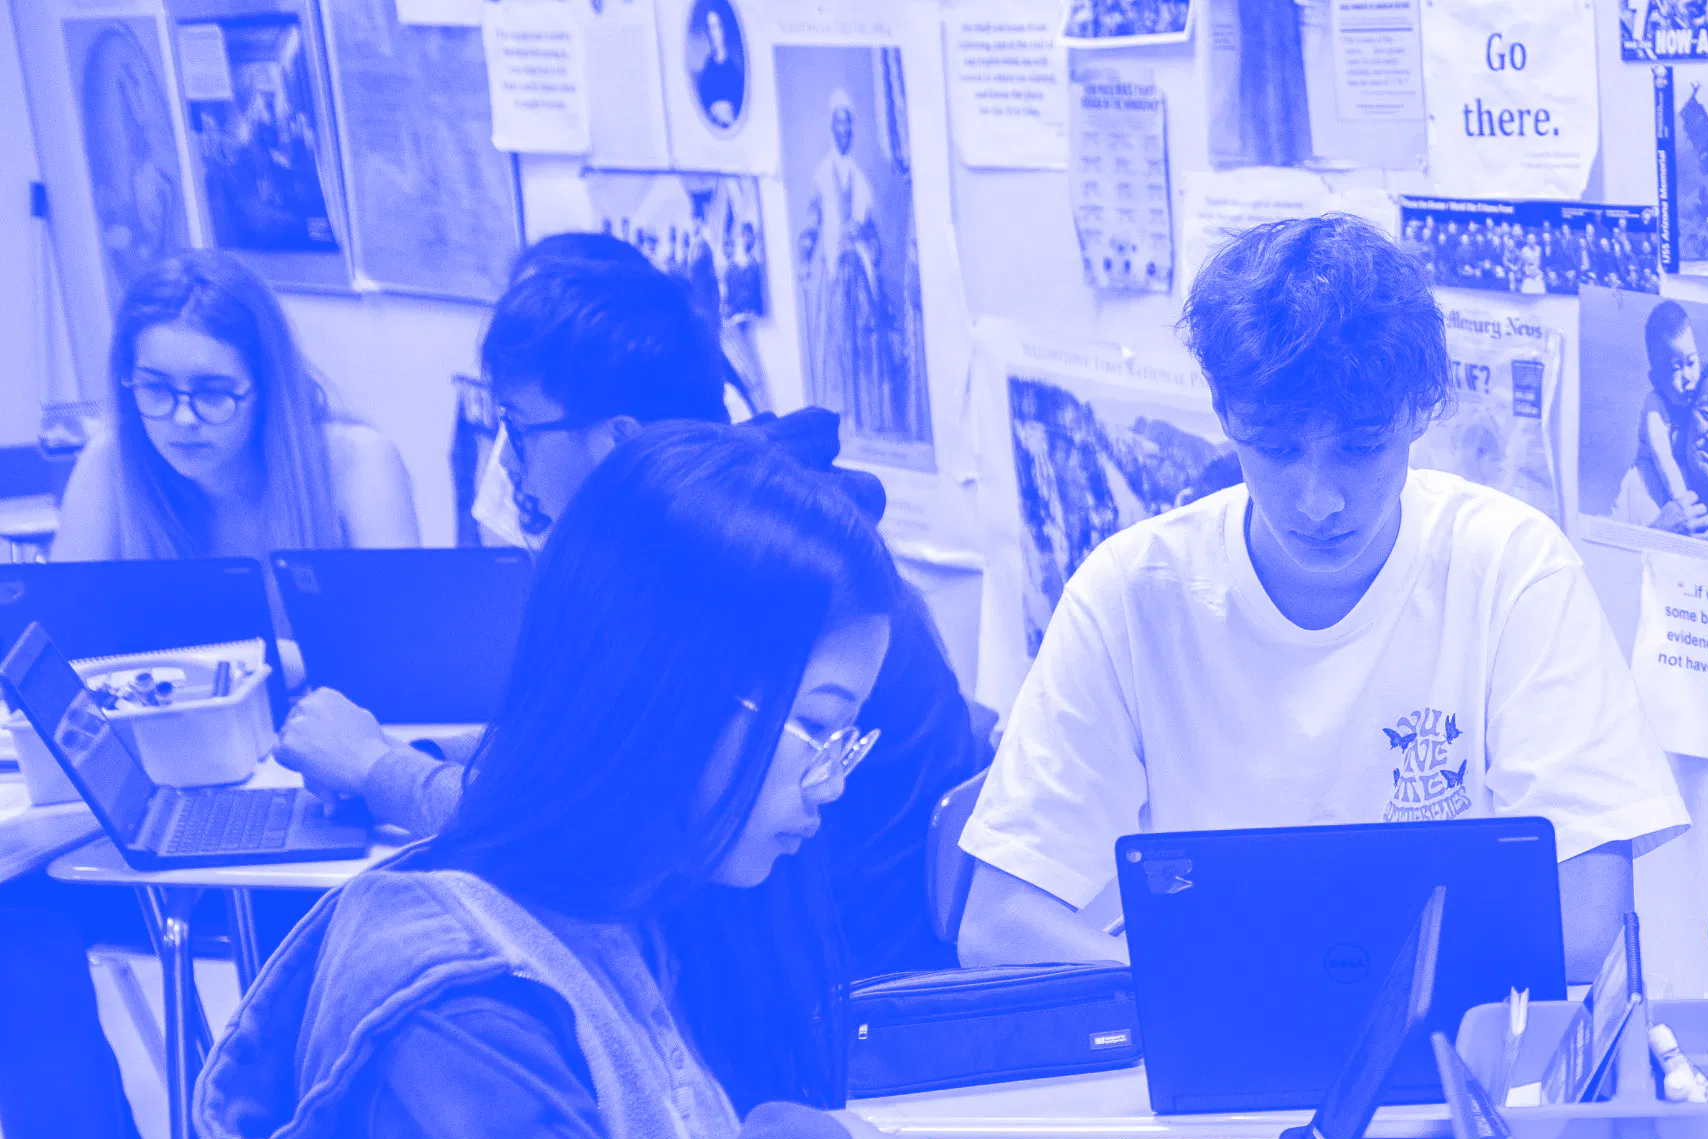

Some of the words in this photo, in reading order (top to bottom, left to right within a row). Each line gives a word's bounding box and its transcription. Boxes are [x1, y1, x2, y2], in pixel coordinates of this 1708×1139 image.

[1485, 32, 1527, 72] Go
[1462, 98, 1560, 137] there.
[1505, 316, 1542, 339] News
[1465, 363, 1491, 394] IF?
[1664, 606, 1697, 622] some
[1657, 651, 1683, 668] not
